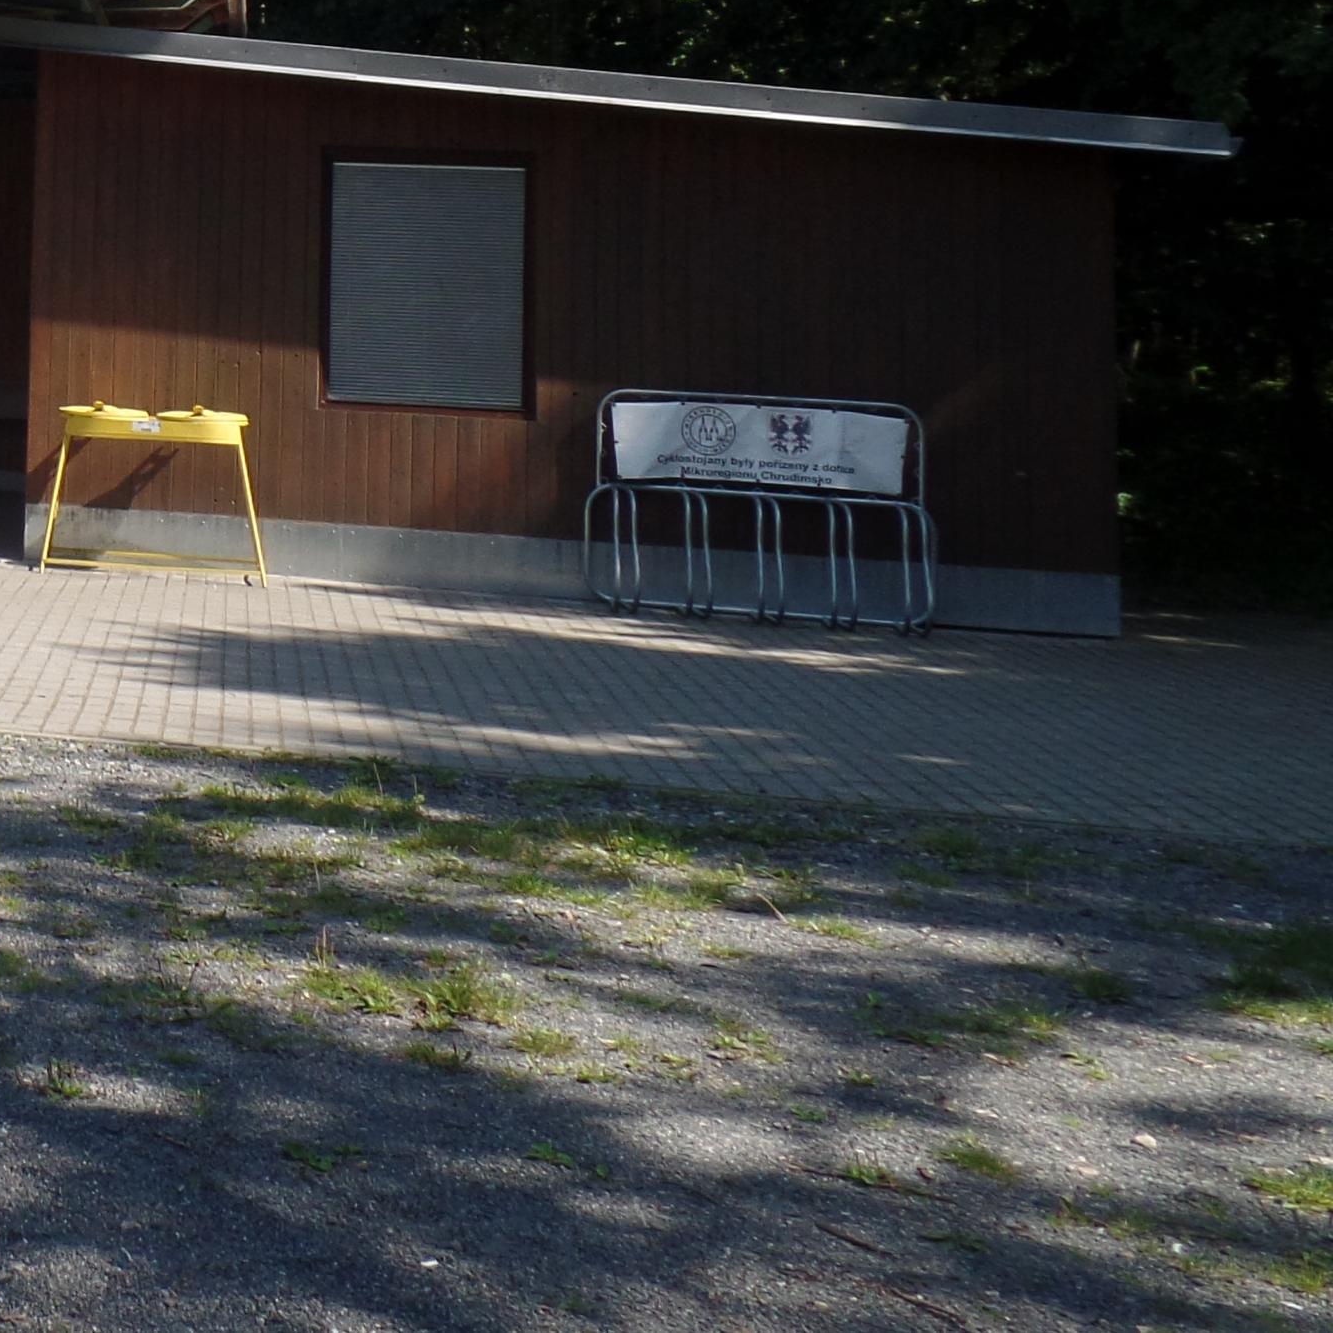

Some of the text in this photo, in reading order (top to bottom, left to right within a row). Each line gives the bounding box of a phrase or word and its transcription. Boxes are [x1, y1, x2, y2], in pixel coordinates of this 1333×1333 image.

[657, 454, 727, 466] Cyklostojany
[730, 457, 755, 468] byly
[681, 466, 832, 484] Mikroregionu Chrudimsko
